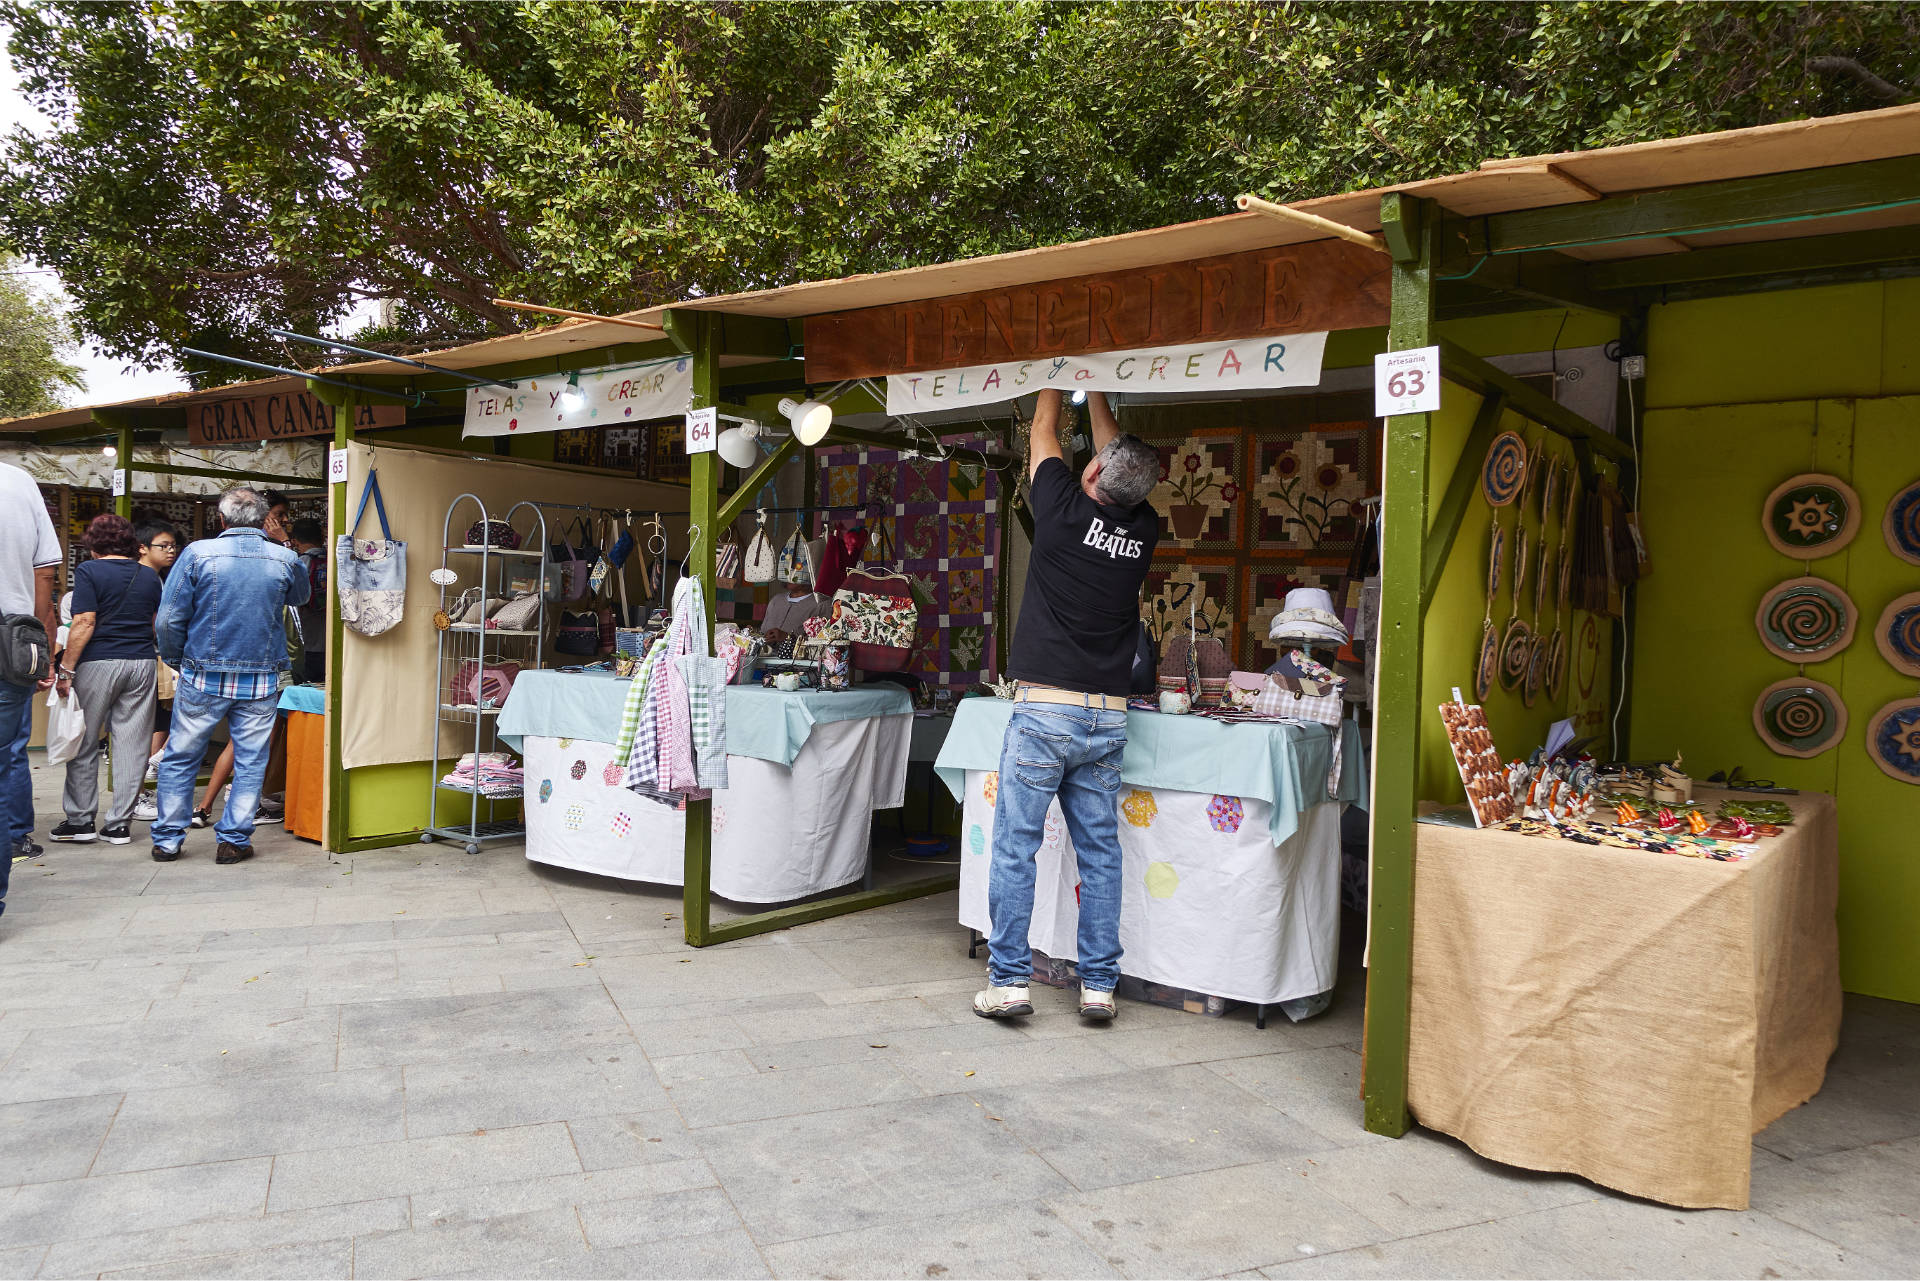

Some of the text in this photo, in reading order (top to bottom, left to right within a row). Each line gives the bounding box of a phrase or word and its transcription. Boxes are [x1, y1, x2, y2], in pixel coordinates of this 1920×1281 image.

[893, 256, 1307, 369] TENERIFE
[908, 363, 1033, 401] TELAS
[1115, 342, 1286, 381] CREAR
[1388, 369, 1425, 398] 63
[478, 394, 527, 418] TELAS
[607, 373, 665, 401] CREAR
[200, 391, 377, 442] GRAN CANAA
[691, 422, 711, 442] 64
[332, 460, 343, 474] 65
[1114, 527, 1128, 536] THE
